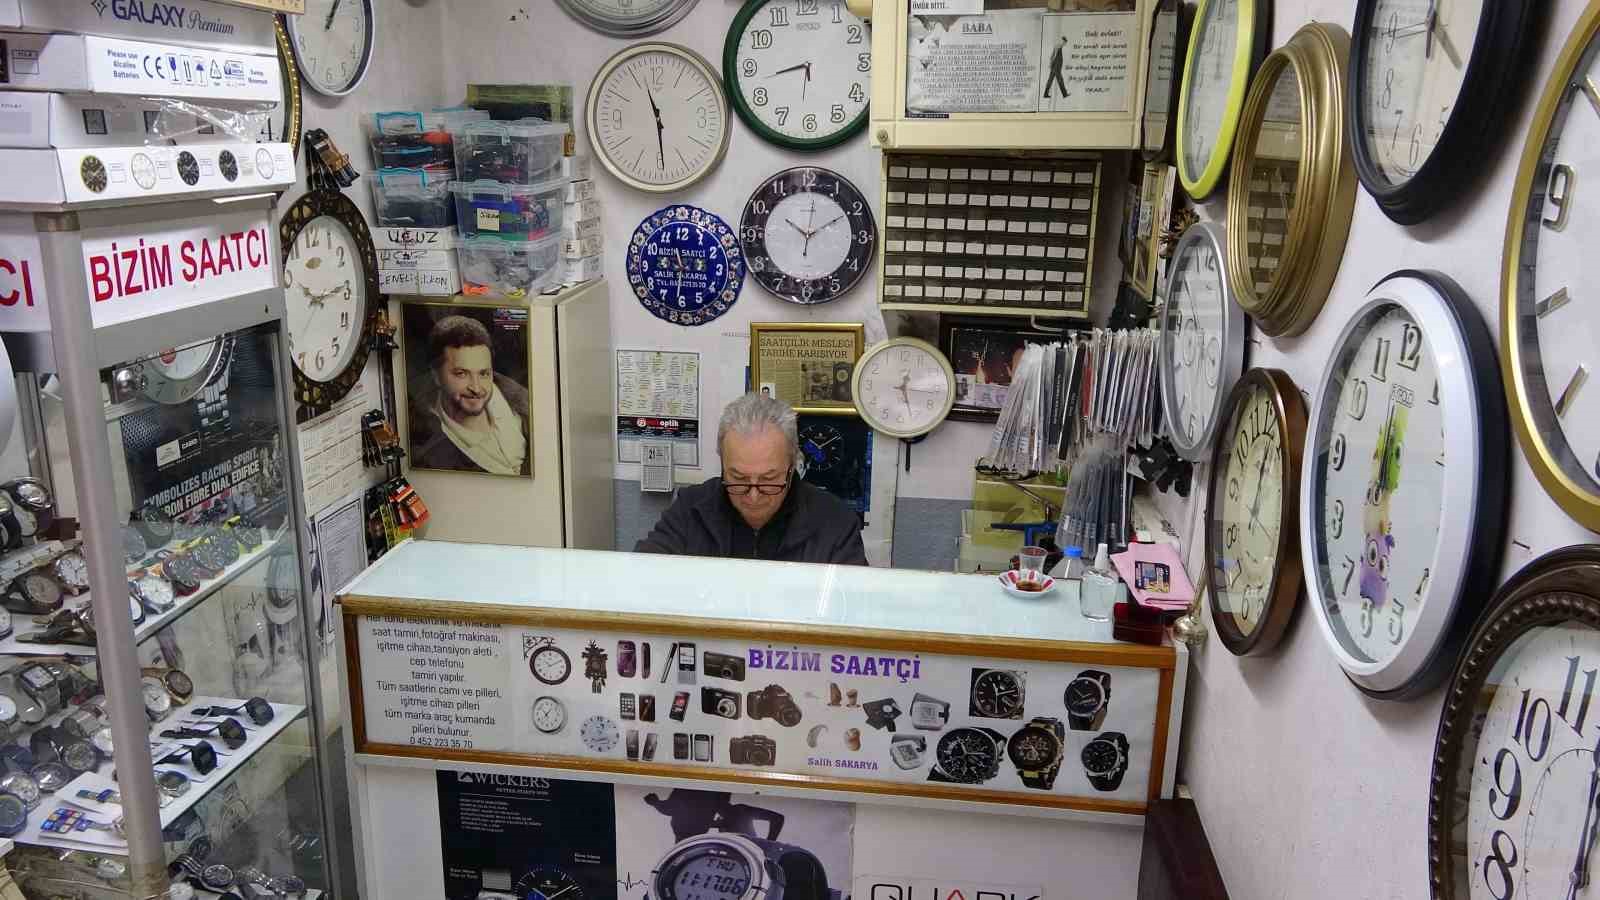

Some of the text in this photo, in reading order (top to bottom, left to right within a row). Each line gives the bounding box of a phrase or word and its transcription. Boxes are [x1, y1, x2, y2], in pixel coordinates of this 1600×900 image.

[795, 0, 817, 15] 12
[830, 3, 842, 24] 1
[112, 0, 234, 34] GALAXY Premium
[770, 7, 789, 27] 11
[847, 25, 863, 44] 2
[962, 23, 992, 33] BABA
[751, 30, 772, 50] 10
[742, 59, 758, 77] 9
[857, 53, 872, 72] 3
[650, 66, 664, 87] 12
[753, 87, 768, 107] 8
[848, 83, 864, 102] 4
[1377, 68, 1394, 110] 8
[612, 109, 622, 130] 9
[696, 107, 707, 129] 3
[775, 107, 790, 126] 7
[802, 114, 817, 132] 6
[830, 104, 846, 124] 5
[1386, 109, 1404, 157] 7
[1408, 123, 1423, 168] 6
[771, 180, 786, 195] 11
[802, 172, 817, 188] 12
[834, 180, 840, 195] 1
[1543, 163, 1576, 233] 9
[751, 200, 767, 215] 10
[852, 201, 864, 216] 2
[660, 232, 671, 244] 11
[676, 227, 689, 241] 12
[746, 228, 757, 243] 9
[858, 228, 869, 243] 3
[646, 243, 658, 256] 10
[709, 246, 718, 259] 2
[90, 238, 174, 303] BİZİM
[642, 260, 649, 273] 9
[715, 264, 723, 276] 3
[754, 255, 765, 270] 8
[848, 257, 859, 272] 4
[647, 277, 655, 291] 8
[774, 278, 785, 291] 7
[801, 282, 813, 300] 6
[829, 278, 841, 292] 5
[659, 289, 668, 301] 7
[678, 296, 686, 308] 6
[695, 292, 703, 304] 5
[1396, 322, 1423, 372] 12
[315, 350, 324, 371] 6
[1370, 337, 1391, 383] 11
[1349, 377, 1368, 421] 10
[881, 408, 889, 420] 5
[1330, 433, 1346, 472] 9
[201, 459, 233, 485] RACING
[185, 459, 261, 510] FIBRE DIAL EDIFICE
[1331, 500, 1344, 540] 8
[1226, 523, 1238, 550] 8
[1341, 555, 1355, 597] 7
[372, 627, 391, 637] saat
[376, 640, 405, 653] işitme
[472, 646, 492, 657] aleti
[409, 658, 465, 669] cep telefonu
[748, 644, 921, 684] BİZİM SAATÇİ
[411, 671, 437, 681] tamiri
[376, 680, 397, 692] Tüm
[399, 682, 436, 694] saatlerin
[462, 688, 473, 697] ve
[1555, 655, 1599, 738] 11
[456, 699, 480, 711] pilleri
[384, 709, 496, 726] tüm marka araç kumanda
[1512, 688, 1552, 763] 10
[411, 723, 436, 736] pilleri
[409, 736, 473, 749] 0 452 223 35 70
[807, 757, 879, 771] Salih SAKARYA
[1488, 747, 1523, 822] 9
[707, 857, 735, 872] THU
[1483, 830, 1518, 900] 8
